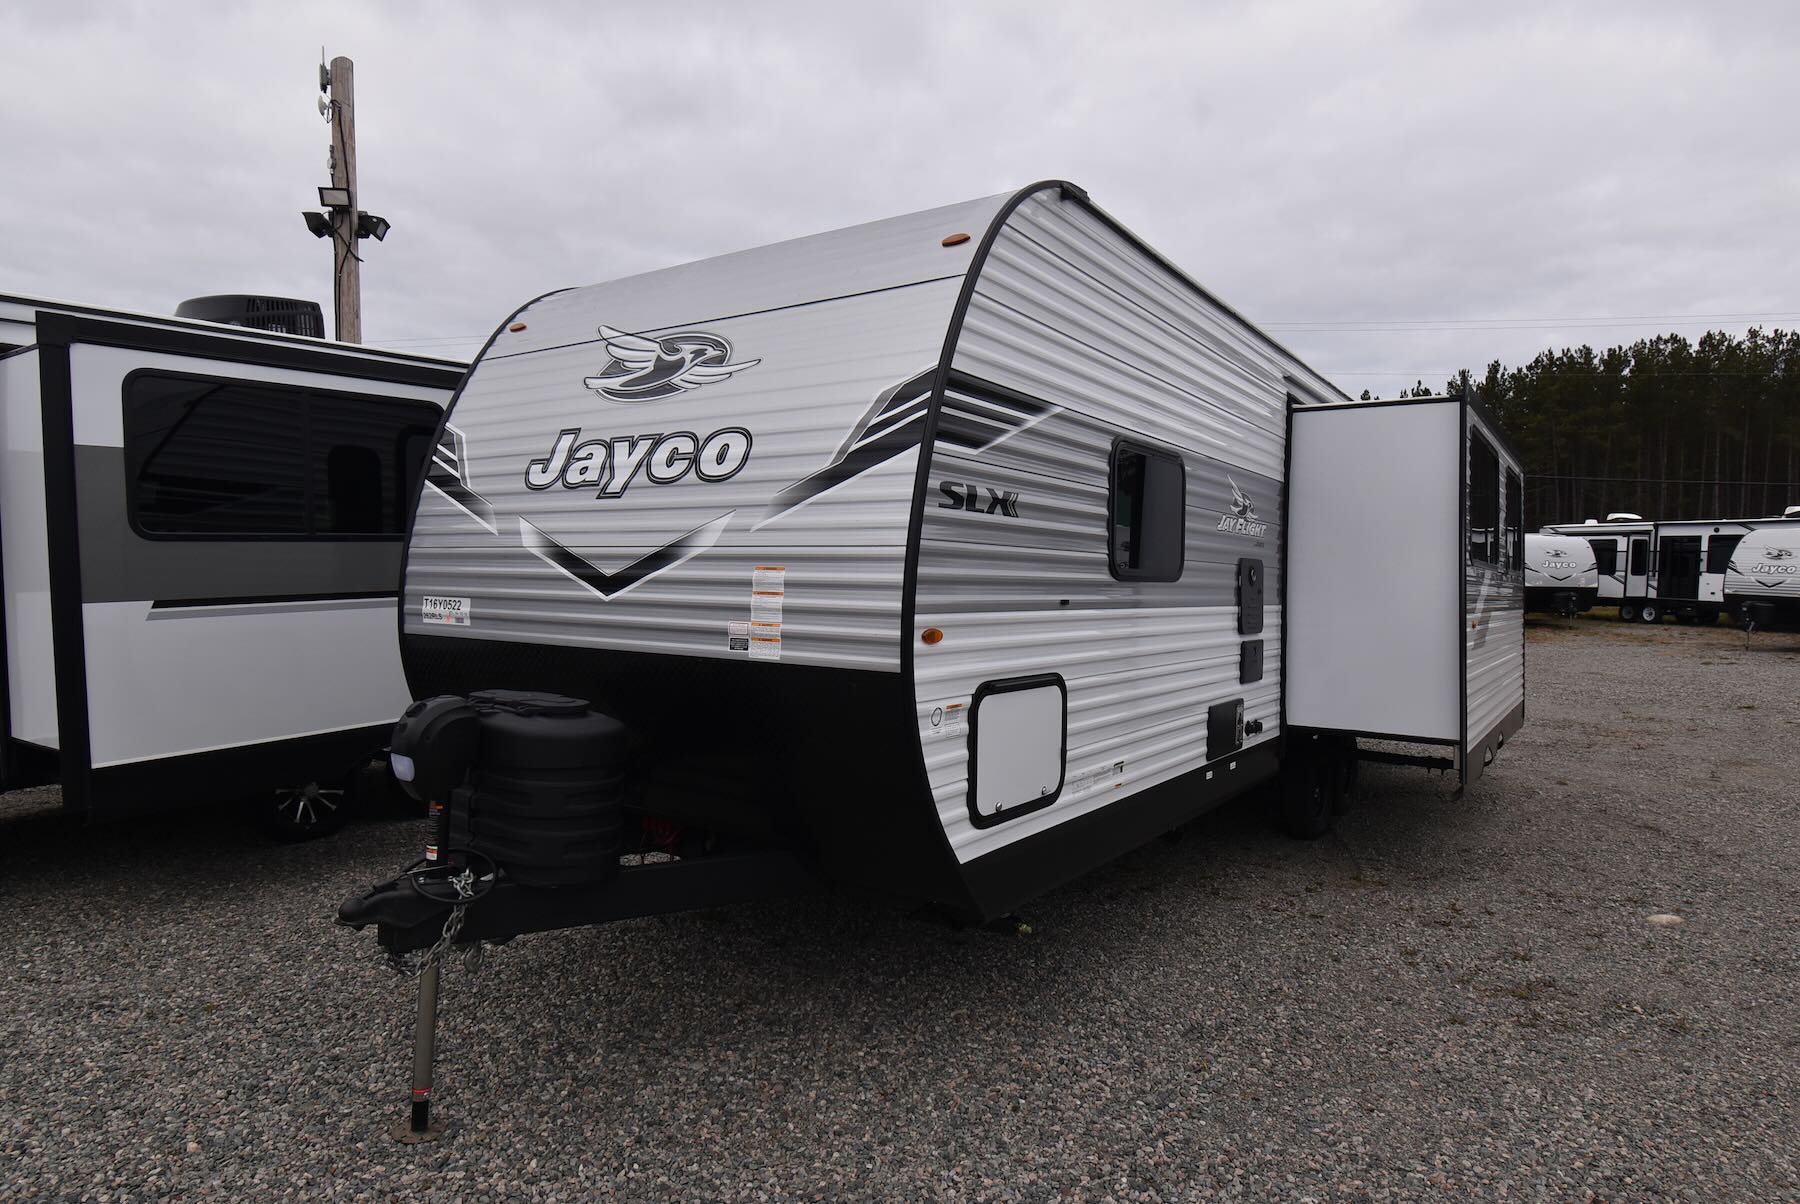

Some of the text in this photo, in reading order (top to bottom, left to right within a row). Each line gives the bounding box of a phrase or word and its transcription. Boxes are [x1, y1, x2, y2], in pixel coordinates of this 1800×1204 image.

[524, 427, 753, 499] Jayco
[938, 481, 1019, 518] SLX
[1217, 514, 1267, 538] JAY FLIGHT
[1541, 559, 1577, 570] Jayco
[1751, 562, 1797, 575] Jayco
[424, 598, 462, 611] T16Y0522
